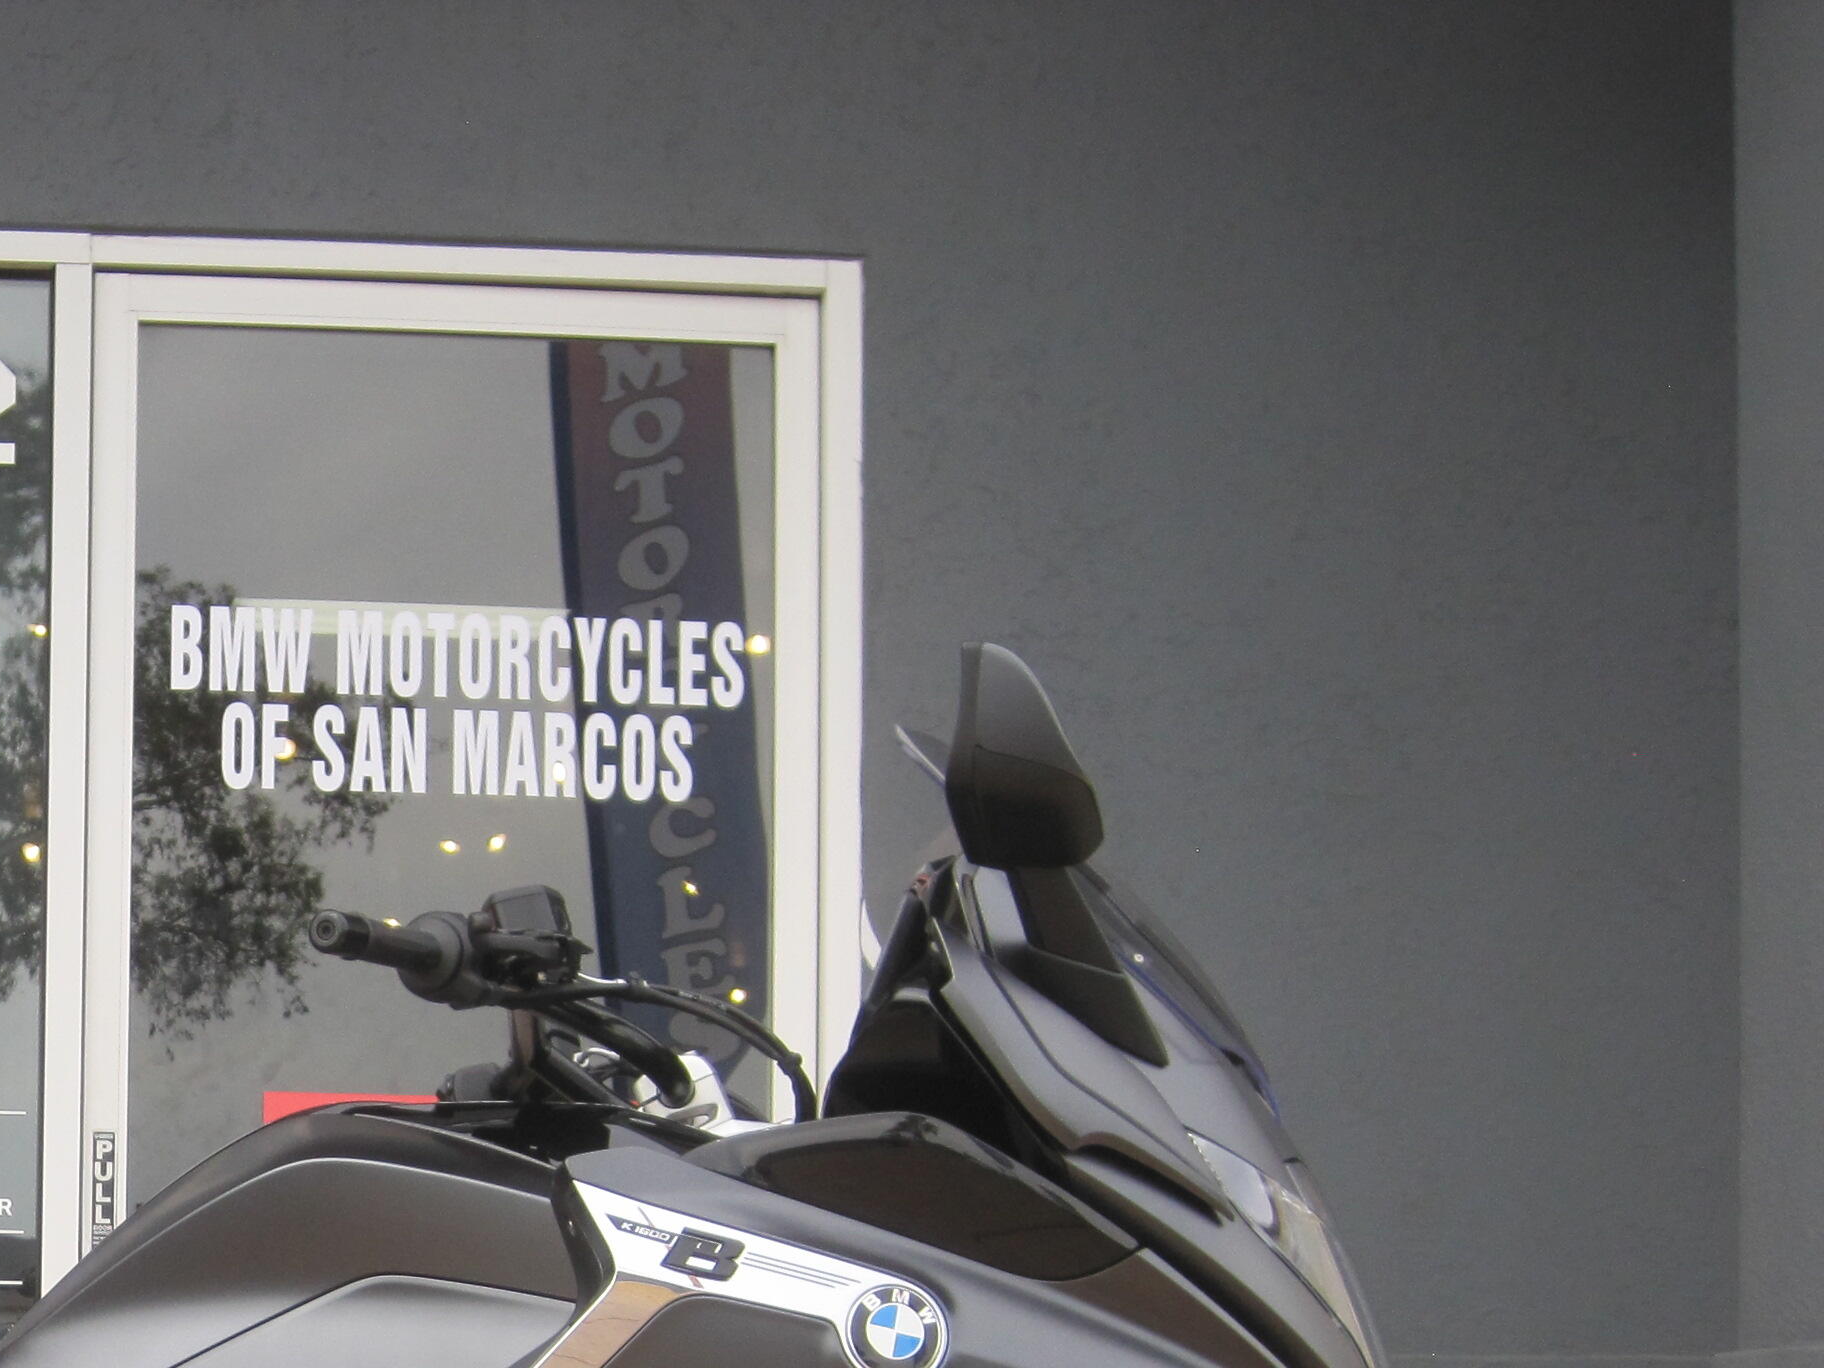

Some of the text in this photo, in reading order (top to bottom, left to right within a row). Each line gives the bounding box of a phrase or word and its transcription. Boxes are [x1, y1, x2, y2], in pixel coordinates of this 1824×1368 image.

[170, 604, 745, 709] BMW MOTORCYCLES
[221, 701, 694, 803] OF SAN MARCOS
[94, 1139, 113, 1224] PULL
[860, 1288, 937, 1325] BMW
